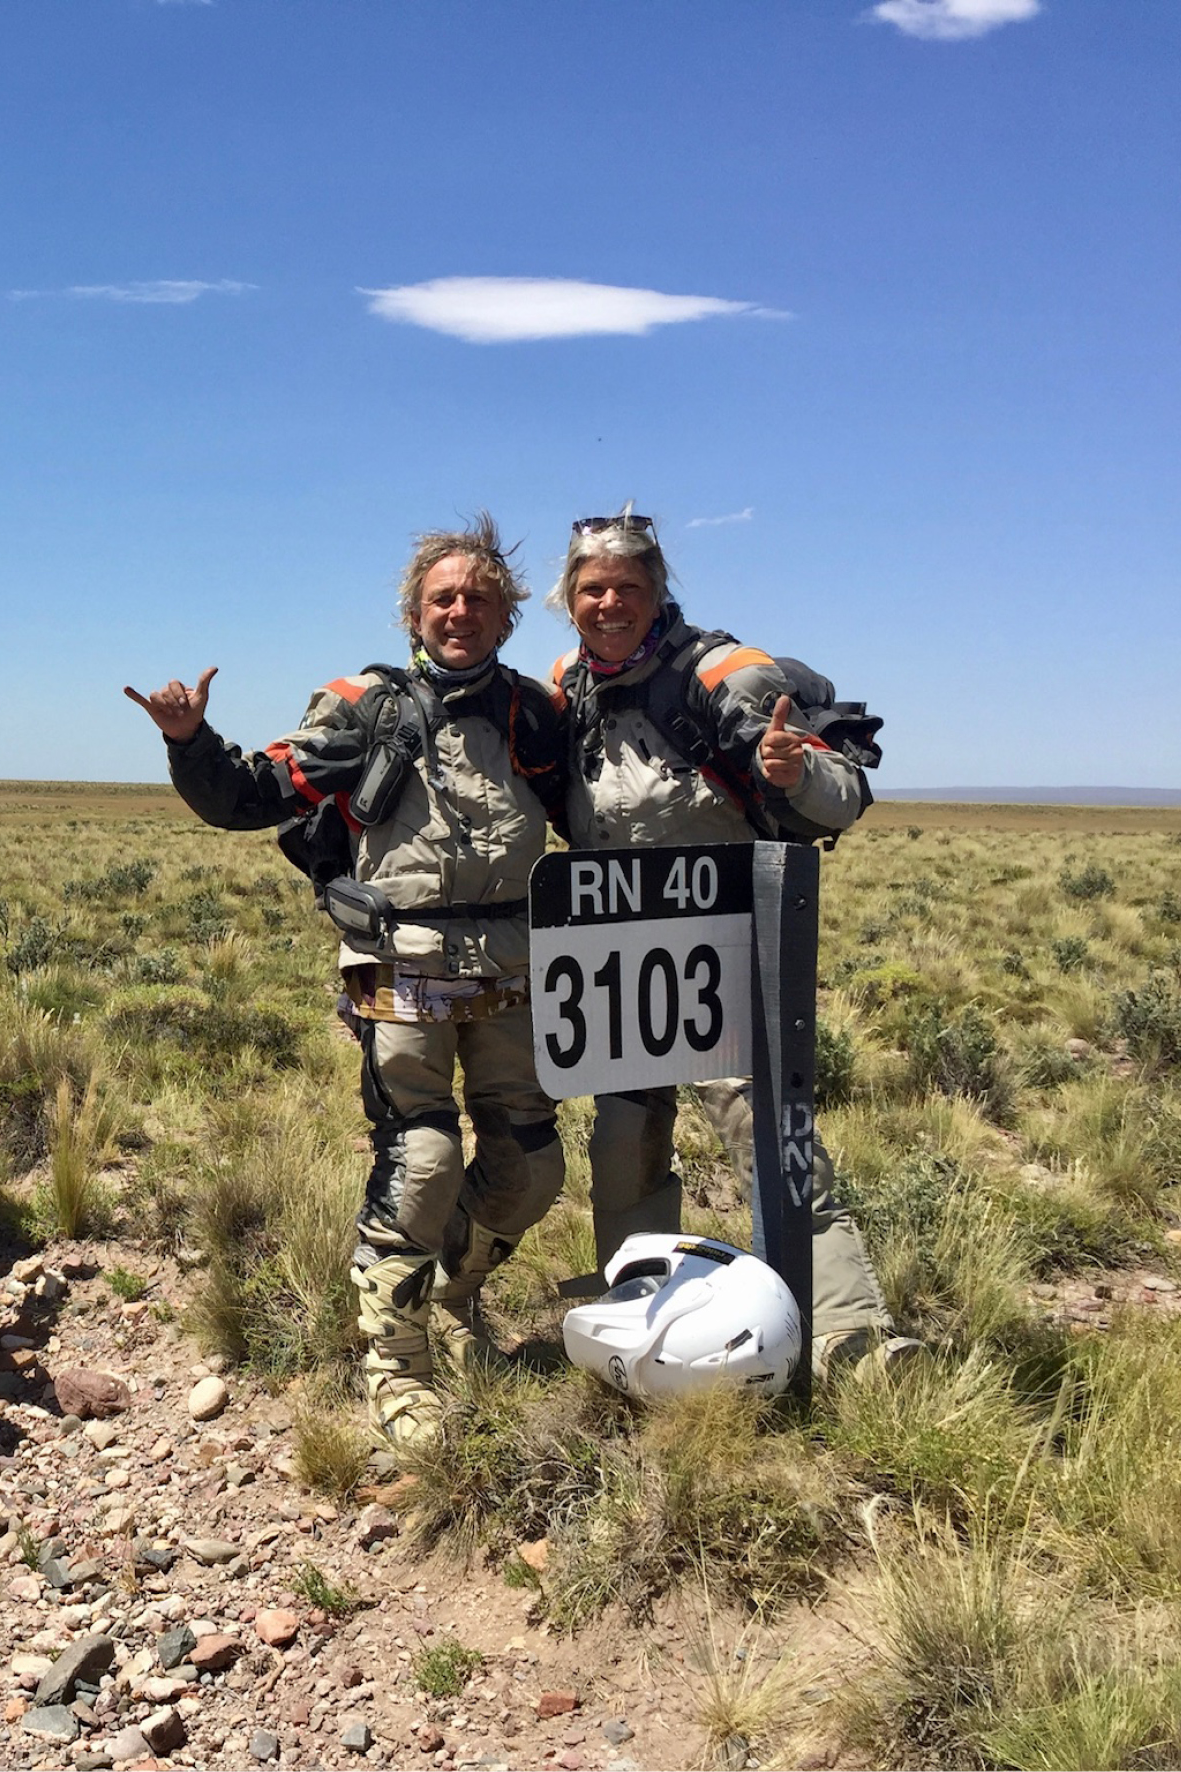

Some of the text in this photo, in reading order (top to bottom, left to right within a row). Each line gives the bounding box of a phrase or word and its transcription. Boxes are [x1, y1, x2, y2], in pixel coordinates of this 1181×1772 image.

[570, 855, 719, 916] RN 40
[544, 943, 723, 1069] 3103
